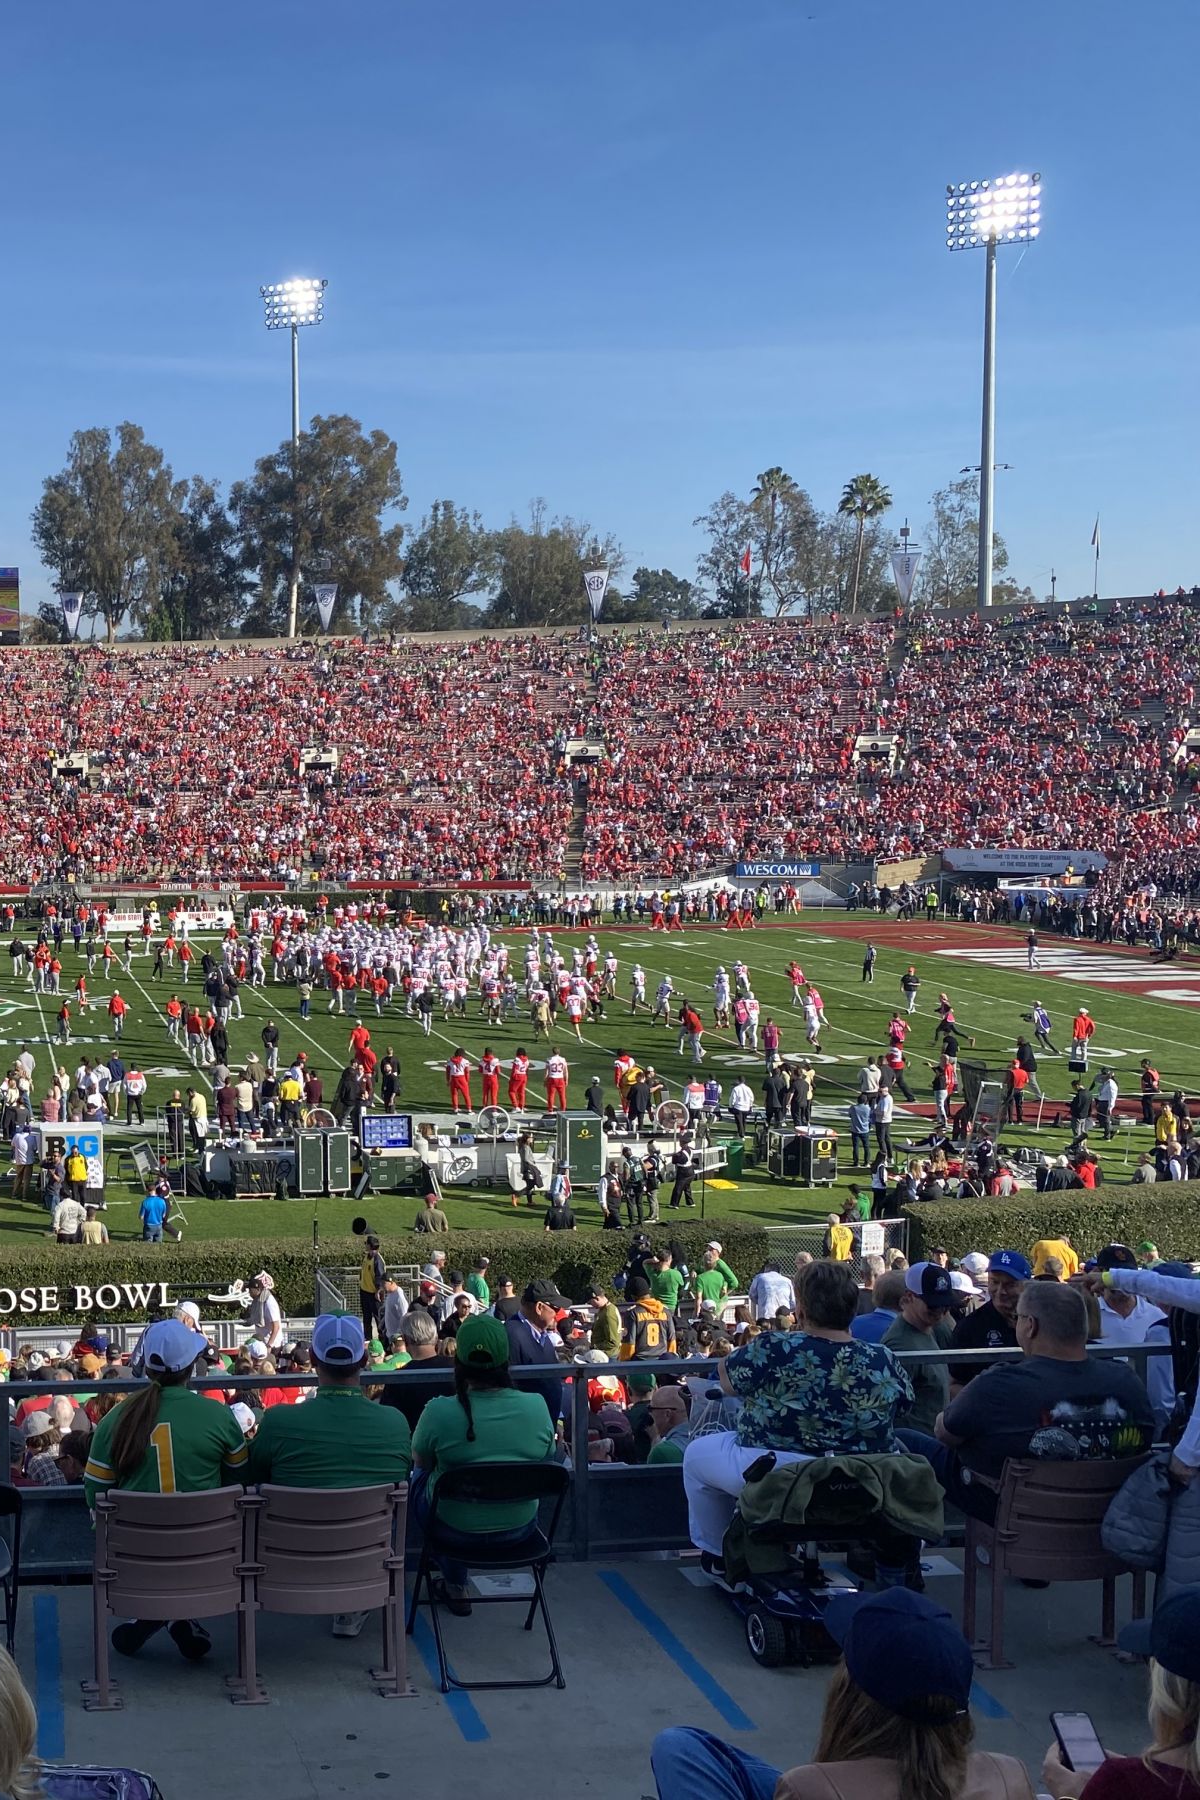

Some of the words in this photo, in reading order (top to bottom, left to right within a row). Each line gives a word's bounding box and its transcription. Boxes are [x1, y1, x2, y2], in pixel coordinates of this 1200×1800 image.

[743, 864, 798, 876] WESCOM
[219, 882, 240, 890] HONOR
[818, 1140, 831, 1152] O
[1001, 1252, 1011, 1264] LA
[75, 1282, 178, 1310] BOWL
[647, 1323, 659, 1347] 8
[150, 1421, 177, 1494] 1
